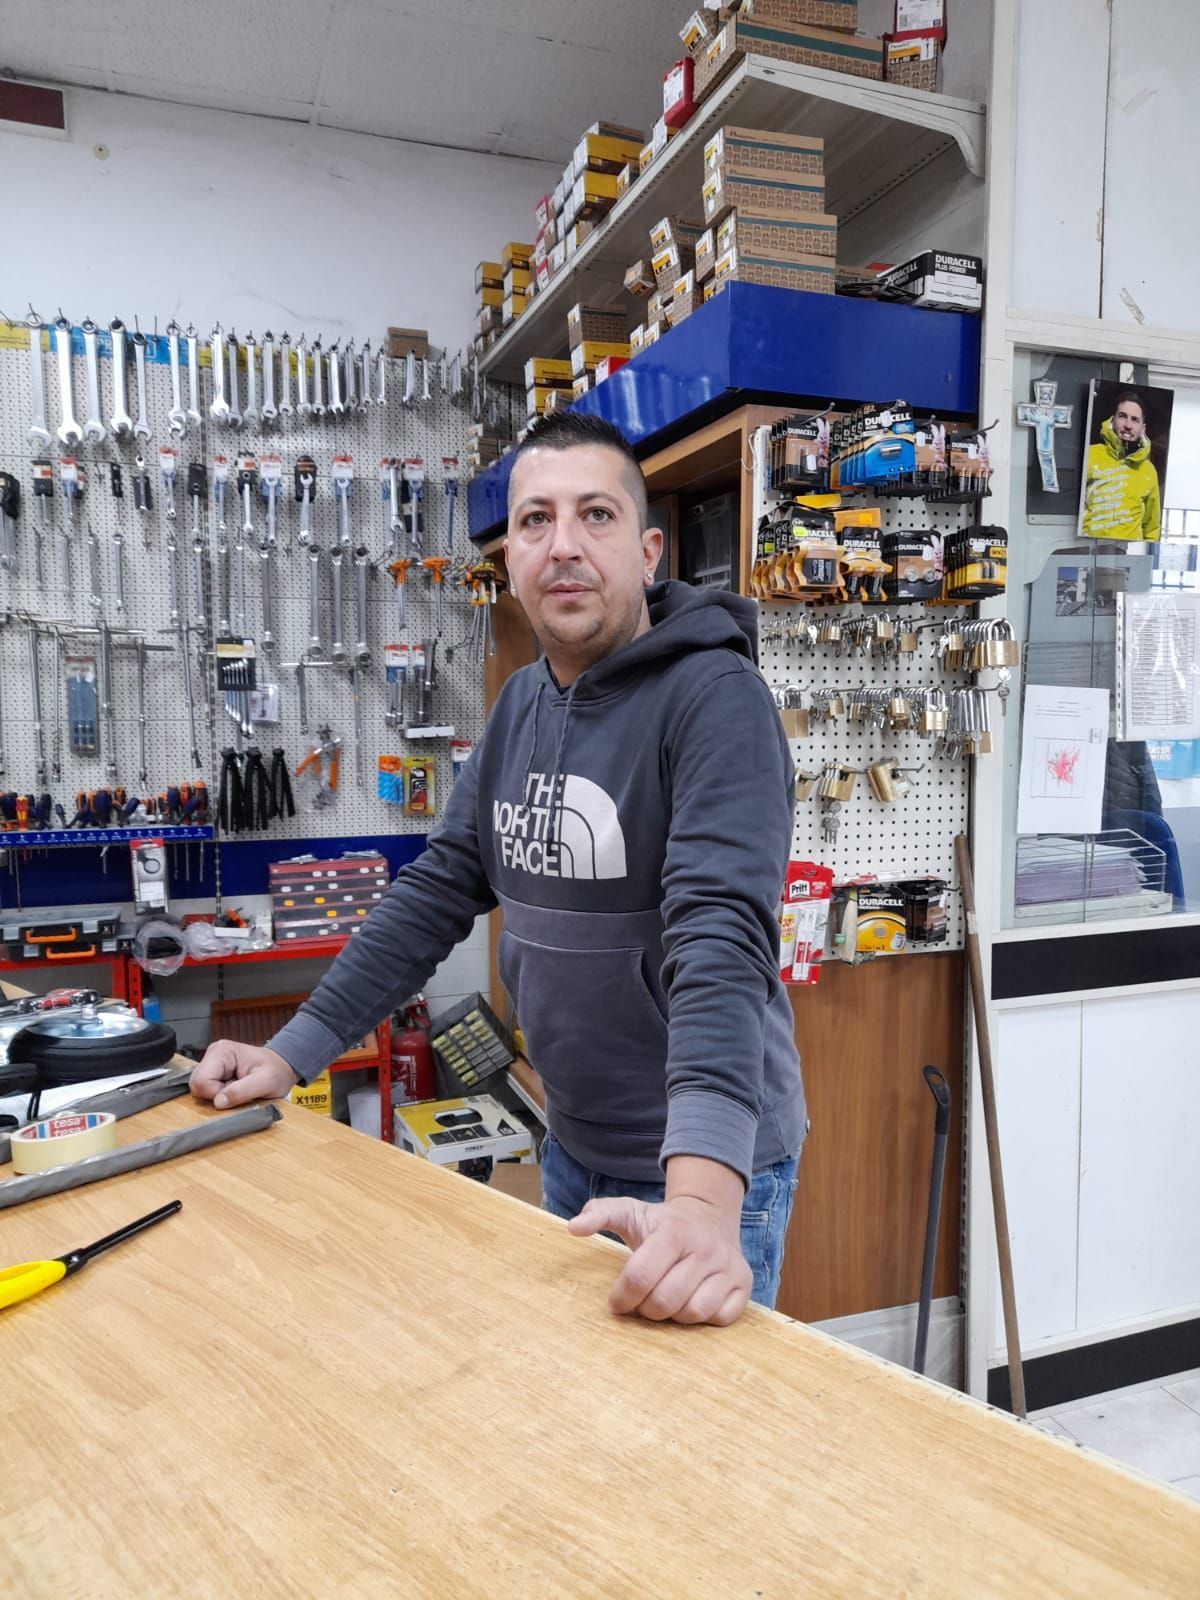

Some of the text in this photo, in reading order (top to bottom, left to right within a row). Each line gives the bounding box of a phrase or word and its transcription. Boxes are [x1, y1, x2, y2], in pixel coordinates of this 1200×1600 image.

[935, 254, 977, 270] DURACELL
[865, 412, 912, 426] DUCELL
[805, 529, 836, 538] RACELL
[843, 539, 881, 548] DURACELL
[501, 835, 560, 878] FACE
[791, 884, 808, 894] Pritt
[859, 898, 904, 907] DURACELL
[296, 1094, 327, 1105] X1189
[53, 1116, 81, 1129] tesa
